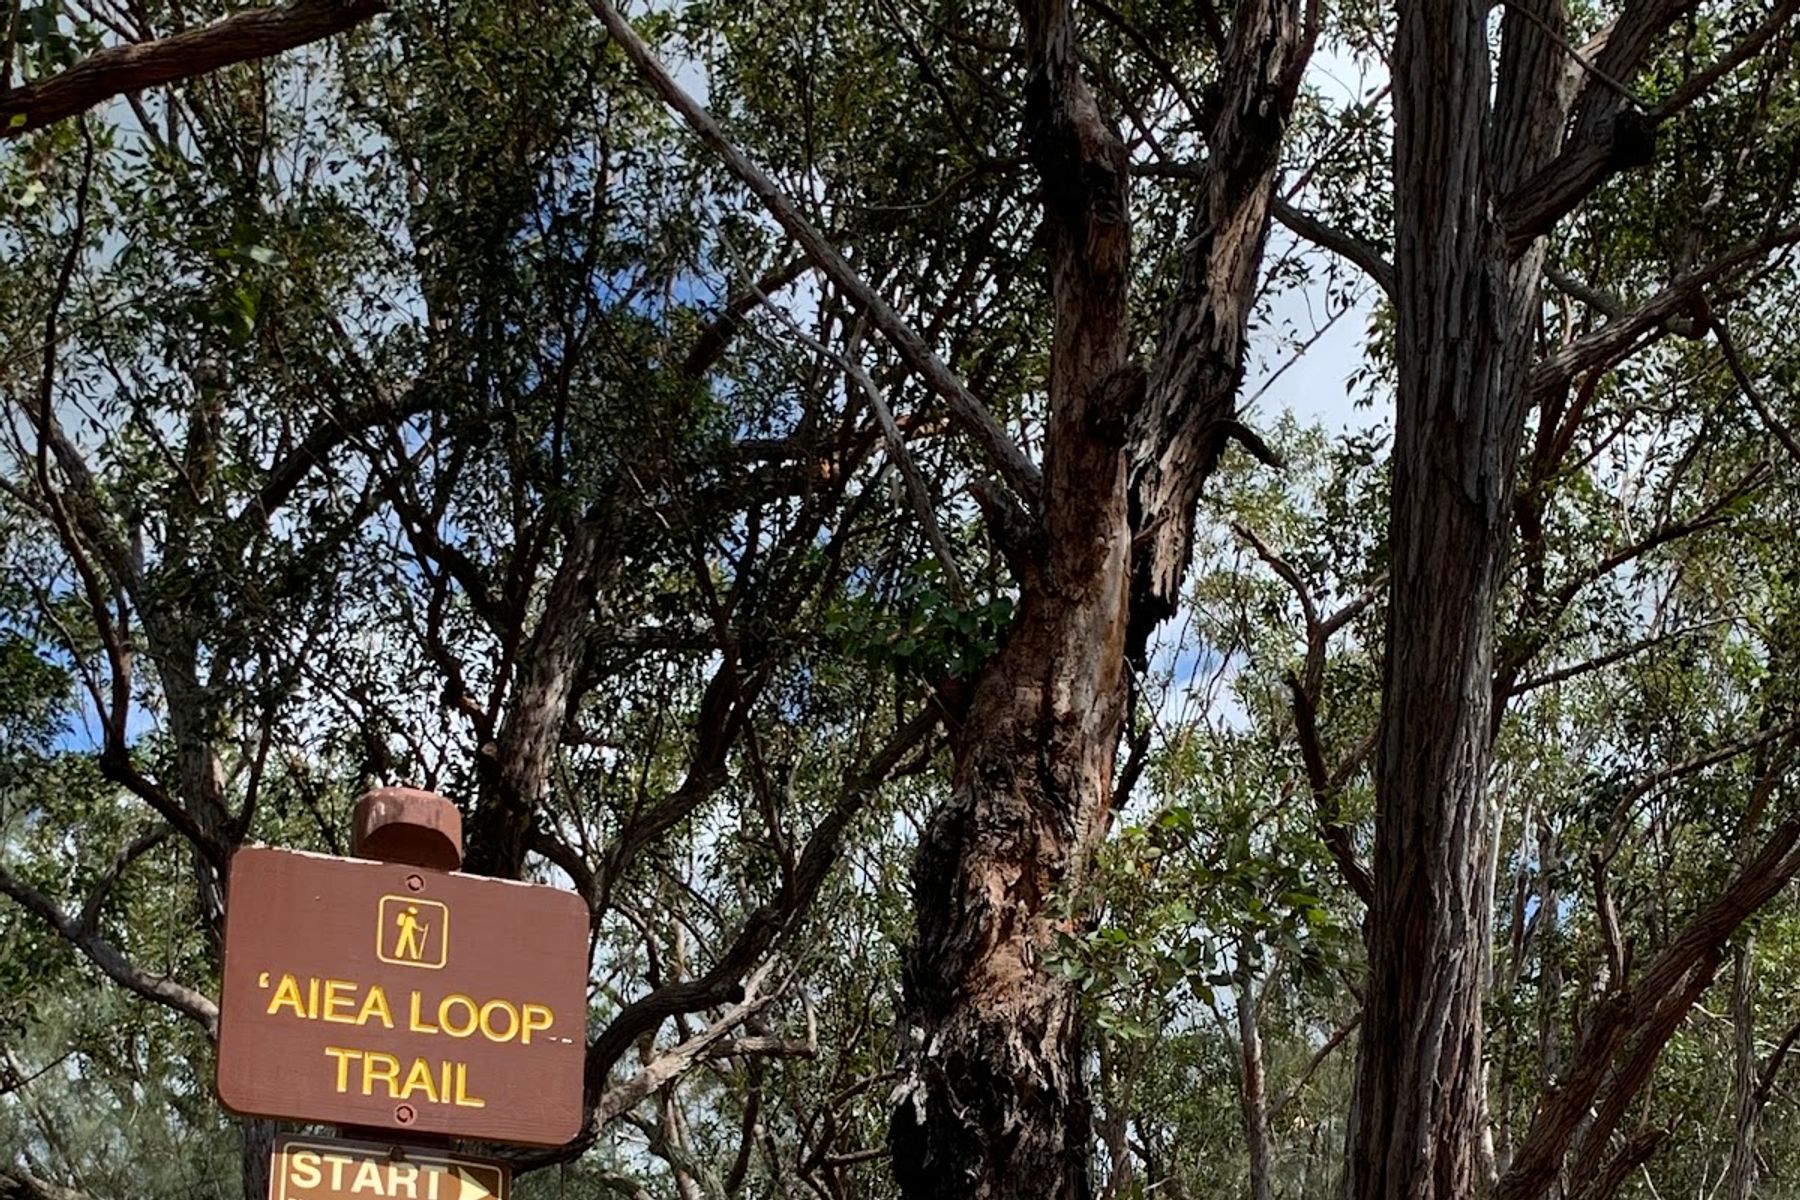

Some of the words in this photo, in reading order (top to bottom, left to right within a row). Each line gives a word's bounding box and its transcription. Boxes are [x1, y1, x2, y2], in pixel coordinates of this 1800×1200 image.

[410, 992, 554, 1044] LOOP
[325, 1047, 485, 1107] TRAIL
[291, 1151, 448, 1200] START
